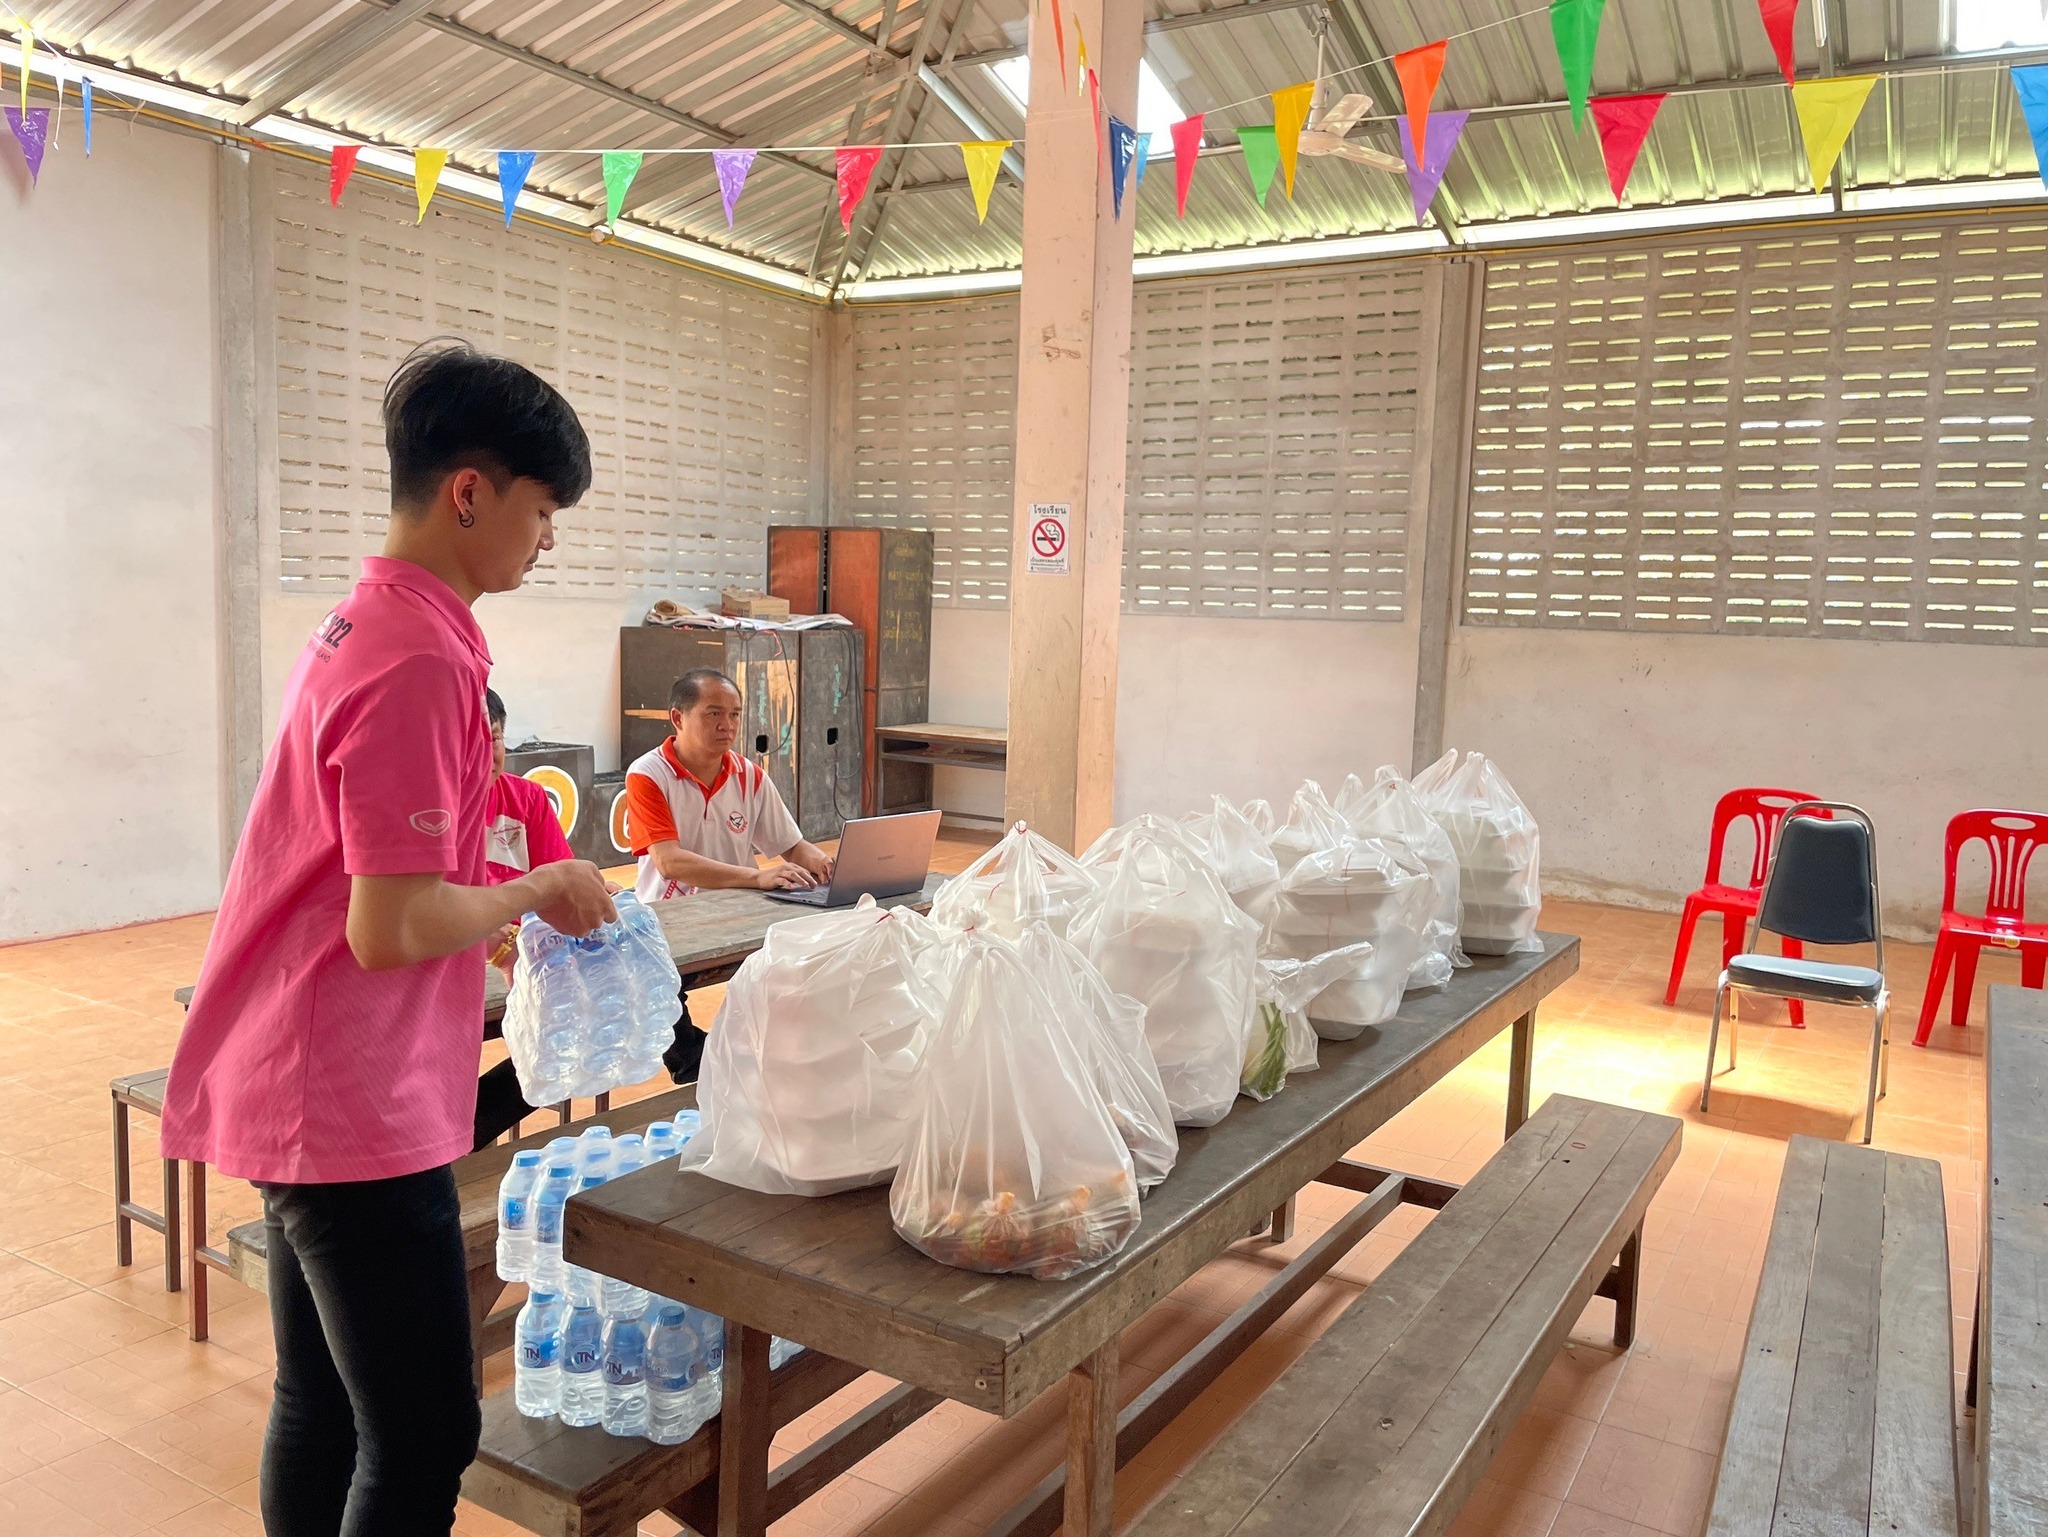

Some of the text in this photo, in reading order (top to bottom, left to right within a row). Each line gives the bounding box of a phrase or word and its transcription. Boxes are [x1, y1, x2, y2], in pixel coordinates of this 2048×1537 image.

[523, 1347, 540, 1359] TN
[576, 1350, 595, 1363] TN
[606, 1361, 622, 1375] TN
